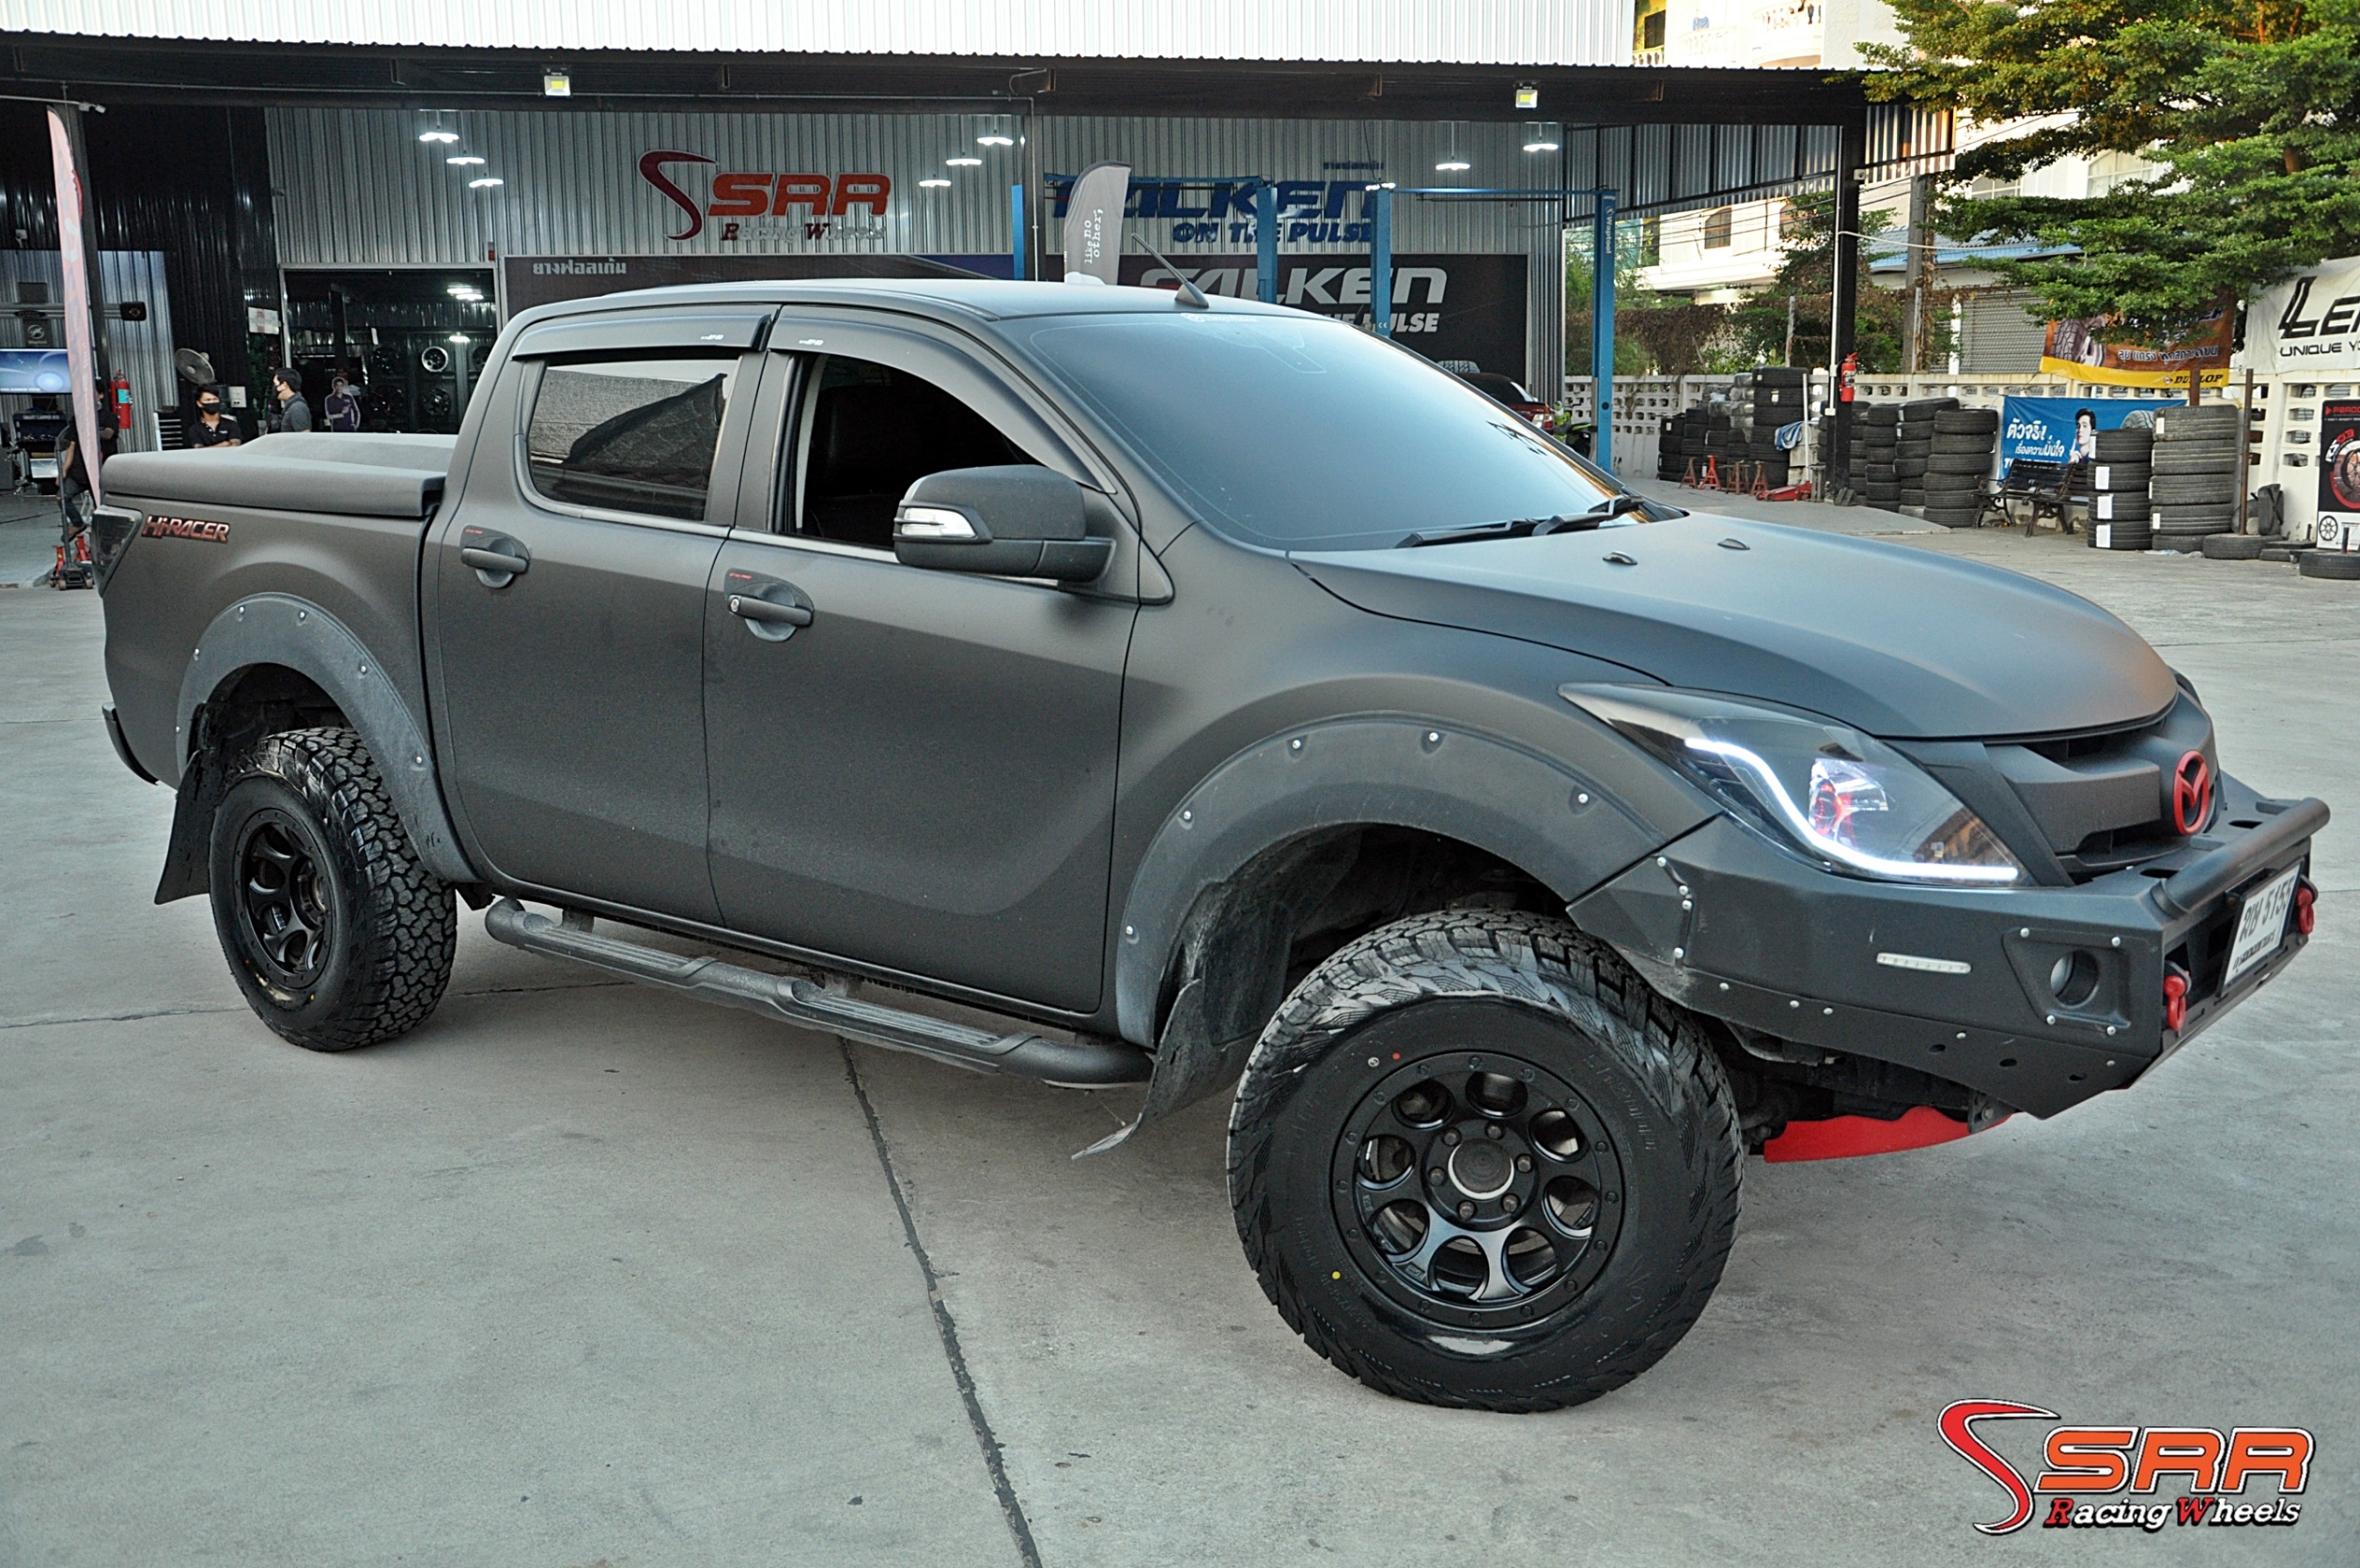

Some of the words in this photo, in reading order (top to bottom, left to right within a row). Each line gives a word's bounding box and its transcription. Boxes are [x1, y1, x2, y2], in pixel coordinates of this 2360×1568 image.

[722, 220, 800, 244] Racing
[805, 221, 887, 241] Wheels
[1084, 220, 1092, 238] no
[1173, 223, 1219, 243] ON
[1286, 223, 1371, 243] PULSE
[1605, 216, 1613, 254] Waptool
[1084, 241, 1094, 264] like
[2279, 342, 2343, 358] UNIQUE
[2173, 374, 2224, 383] DULOP
[2262, 874, 2296, 925] 5155
